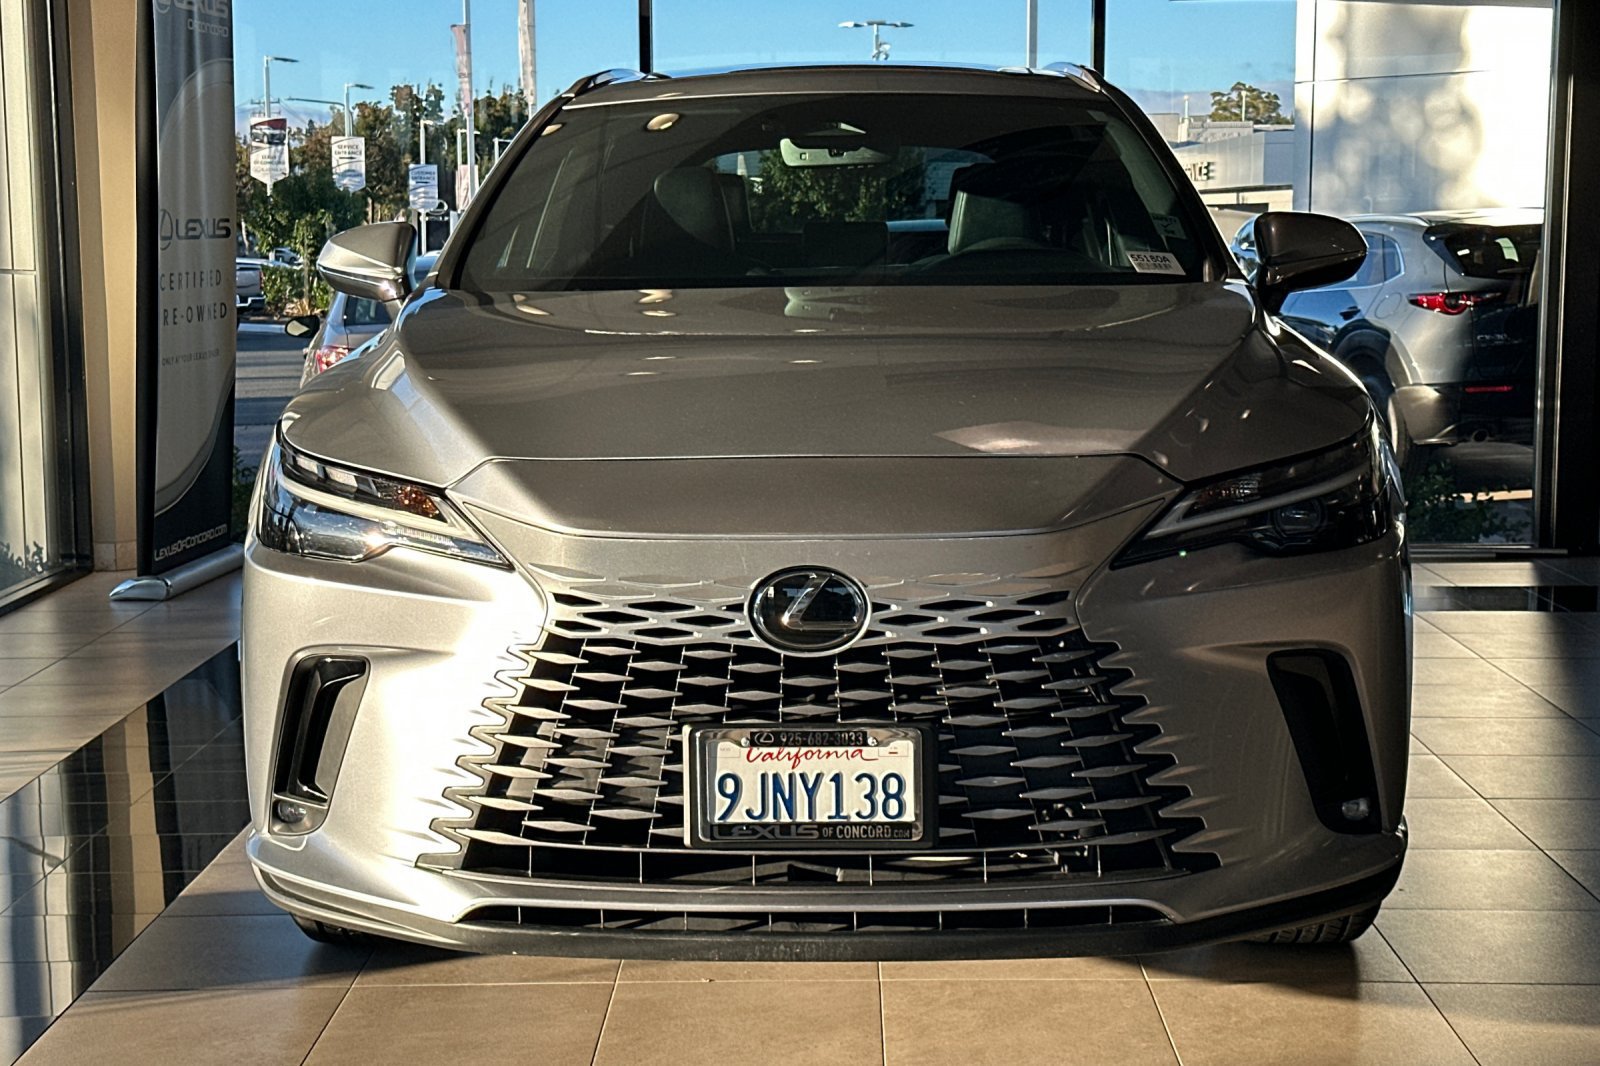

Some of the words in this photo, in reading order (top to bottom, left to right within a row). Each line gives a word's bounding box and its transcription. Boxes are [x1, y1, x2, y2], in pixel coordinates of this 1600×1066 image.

[175, 217, 232, 240] LEXUS
[160, 269, 222, 291] CERTIFIED
[163, 302, 227, 326] RE-OWNED
[780, 732, 863, 747] 925-682-3033
[746, 746, 879, 770] California
[717, 772, 906, 822] 9JNY138
[712, 824, 820, 840] LEXUS
[822, 827, 834, 838] OF
